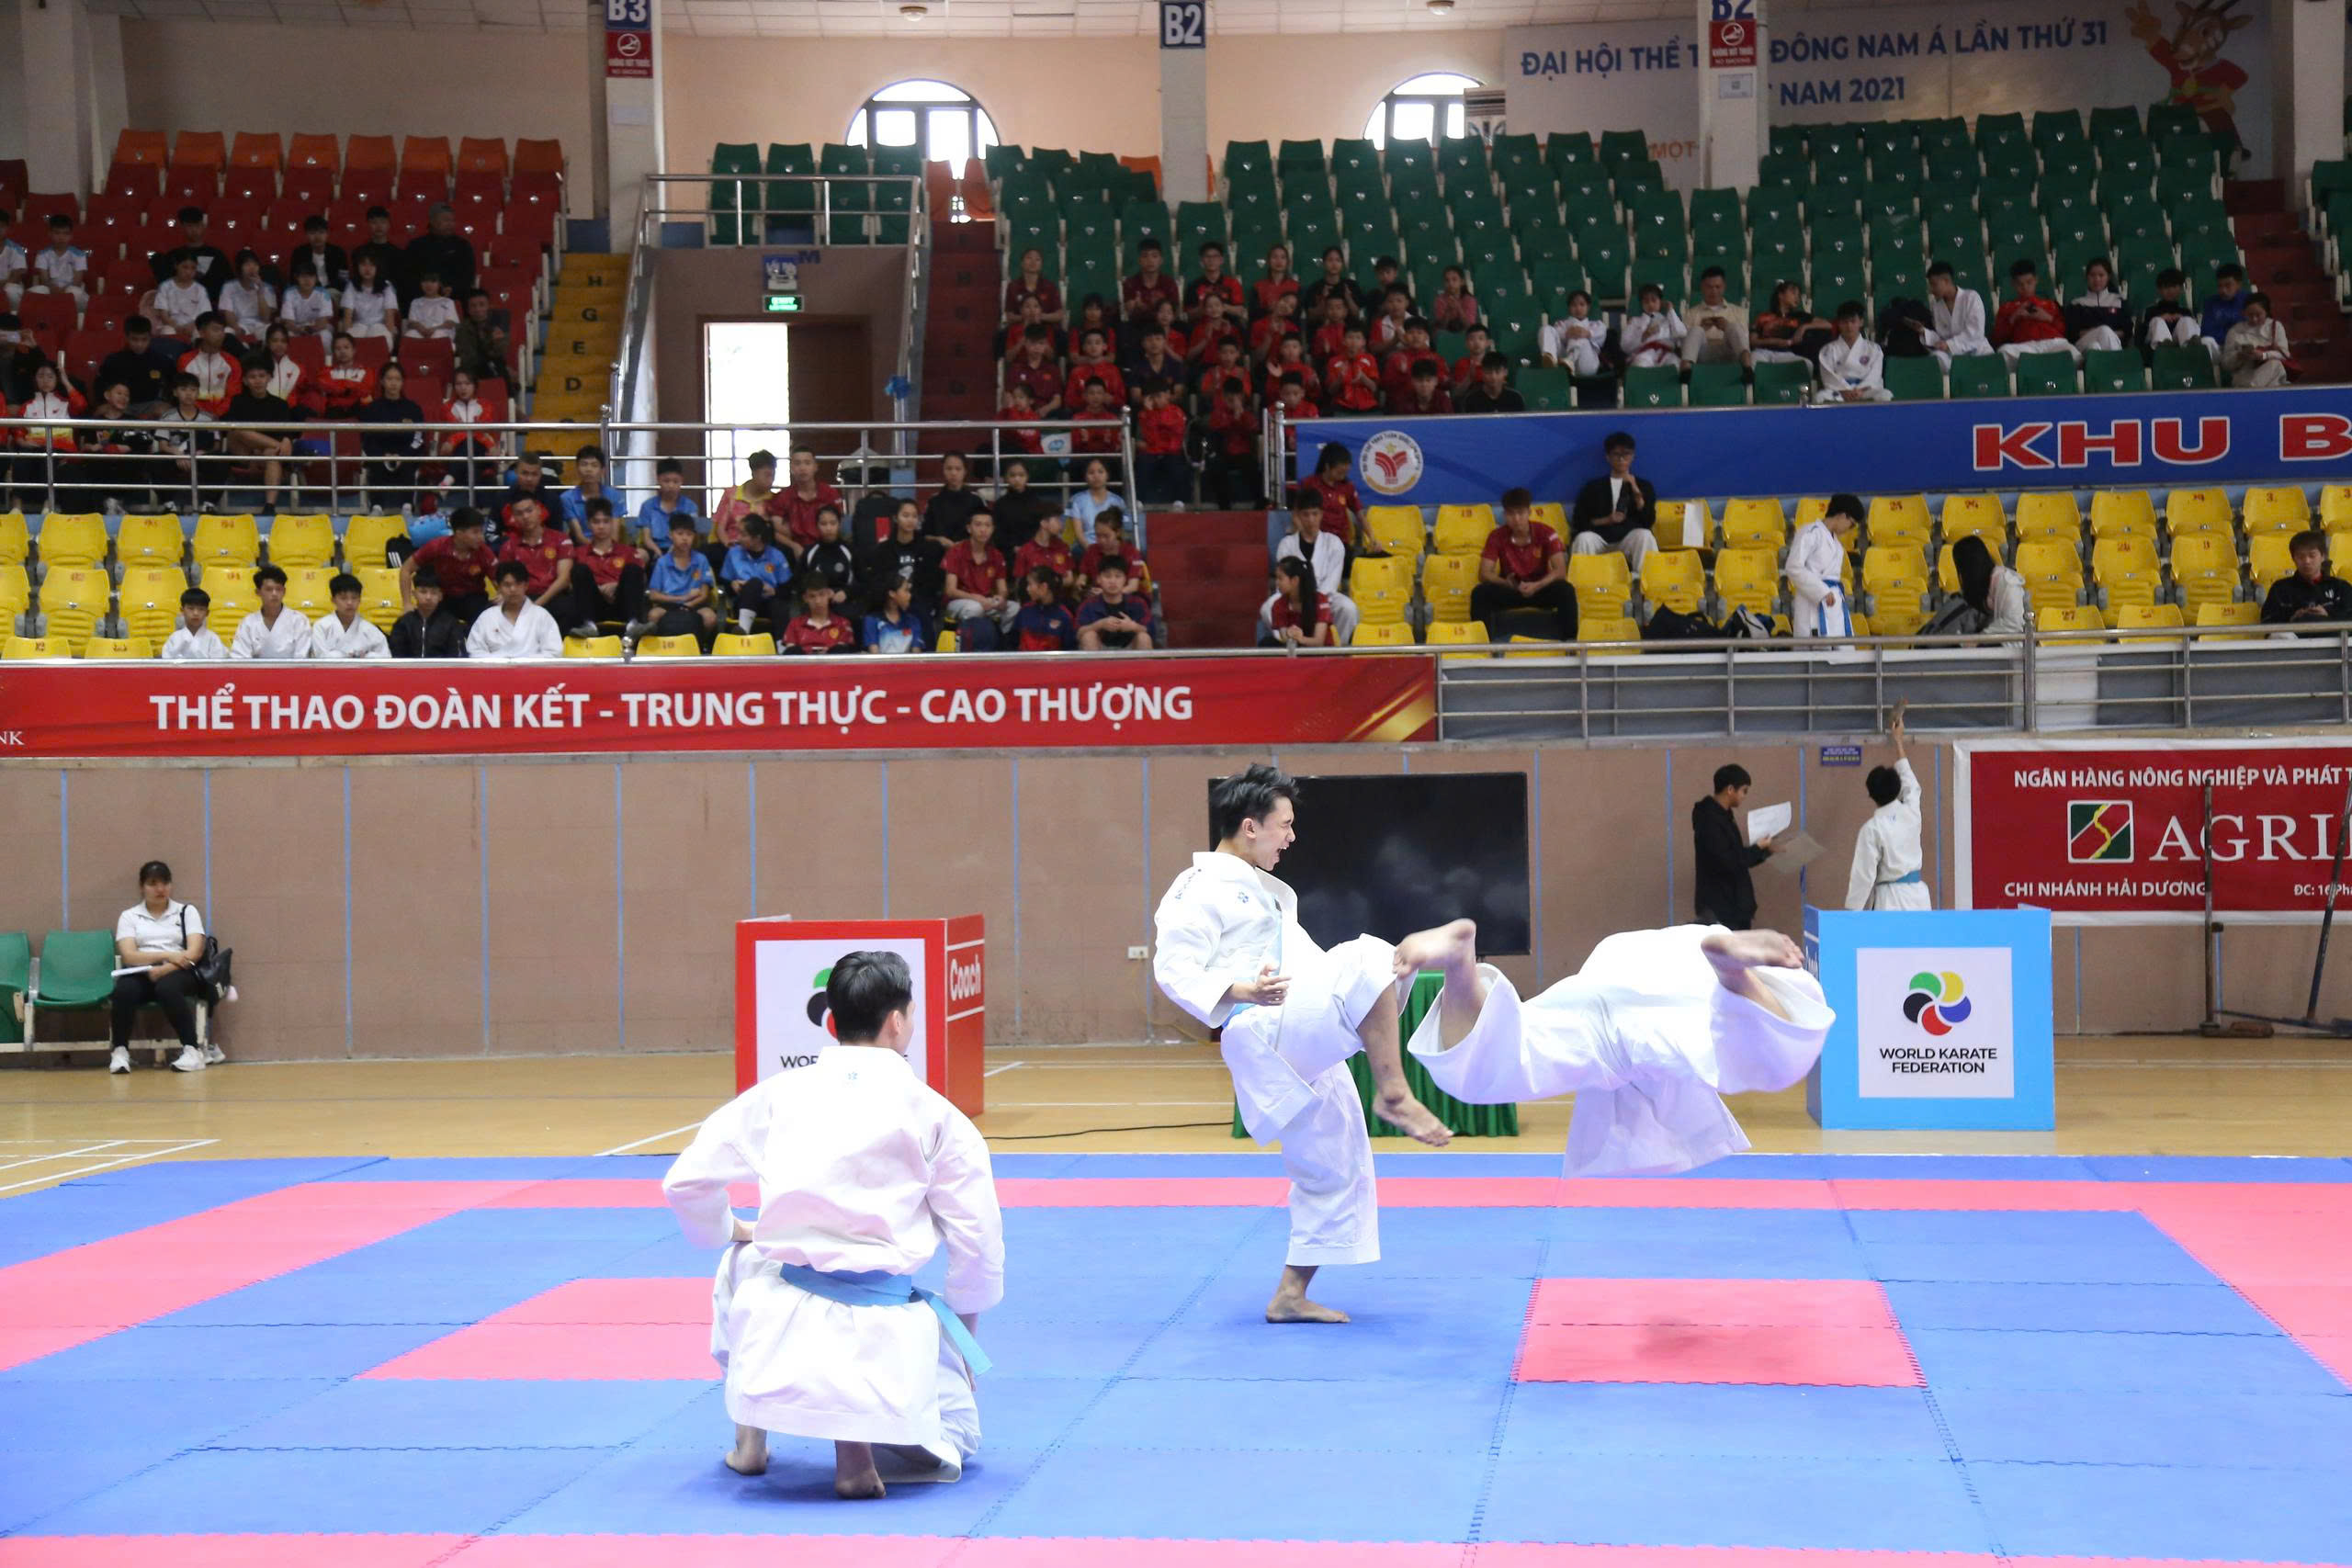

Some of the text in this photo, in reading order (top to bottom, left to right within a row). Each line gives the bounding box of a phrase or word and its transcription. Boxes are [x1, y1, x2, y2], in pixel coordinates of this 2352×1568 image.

[1165, 4, 1202, 44] B2
[1521, 51, 1566, 81] ĐẠI
[1575, 42, 1622, 79] HỘI
[1629, 35, 1680, 70] THỂ
[1769, 31, 1849, 63] ĐÔNG
[1858, 31, 1919, 59] NAM
[1927, 24, 1947, 55] Á
[1955, 18, 2009, 53] LẦN
[2018, 16, 2075, 50] THỨ
[2082, 20, 2108, 46] 31
[1780, 81, 1841, 107] NAM
[1849, 76, 1905, 103] 2021
[582, 308, 598, 321] G
[572, 341, 585, 355] E
[565, 377, 582, 391] D
[1973, 415, 2231, 471] KHU
[150, 682, 236, 730] THỂ
[243, 694, 365, 730] THAO
[374, 687, 502, 728] ĐOÀN
[514, 682, 590, 728] KẾT
[620, 692, 764, 728] TRUNG
[772, 685, 887, 735] THỰC
[920, 688, 1007, 724] CAO
[1013, 682, 1193, 731] THƯỢNG
[2014, 767, 2066, 788] NGÂN
[2071, 766, 2124, 787] HÀNG
[2129, 765, 2184, 787] NÔNG
[2188, 764, 2260, 791] NGHIỆP
[2262, 764, 2289, 785] VÀ
[2292, 763, 2343, 785] PHÁT
[2004, 877, 2205, 897] CHI NHÁNH HẢI DƯƠNG
[950, 953, 982, 1001] Coach
[1879, 1047, 1997, 1059] WORLD KARATE
[1892, 1062, 1985, 1074] FEDERATION
